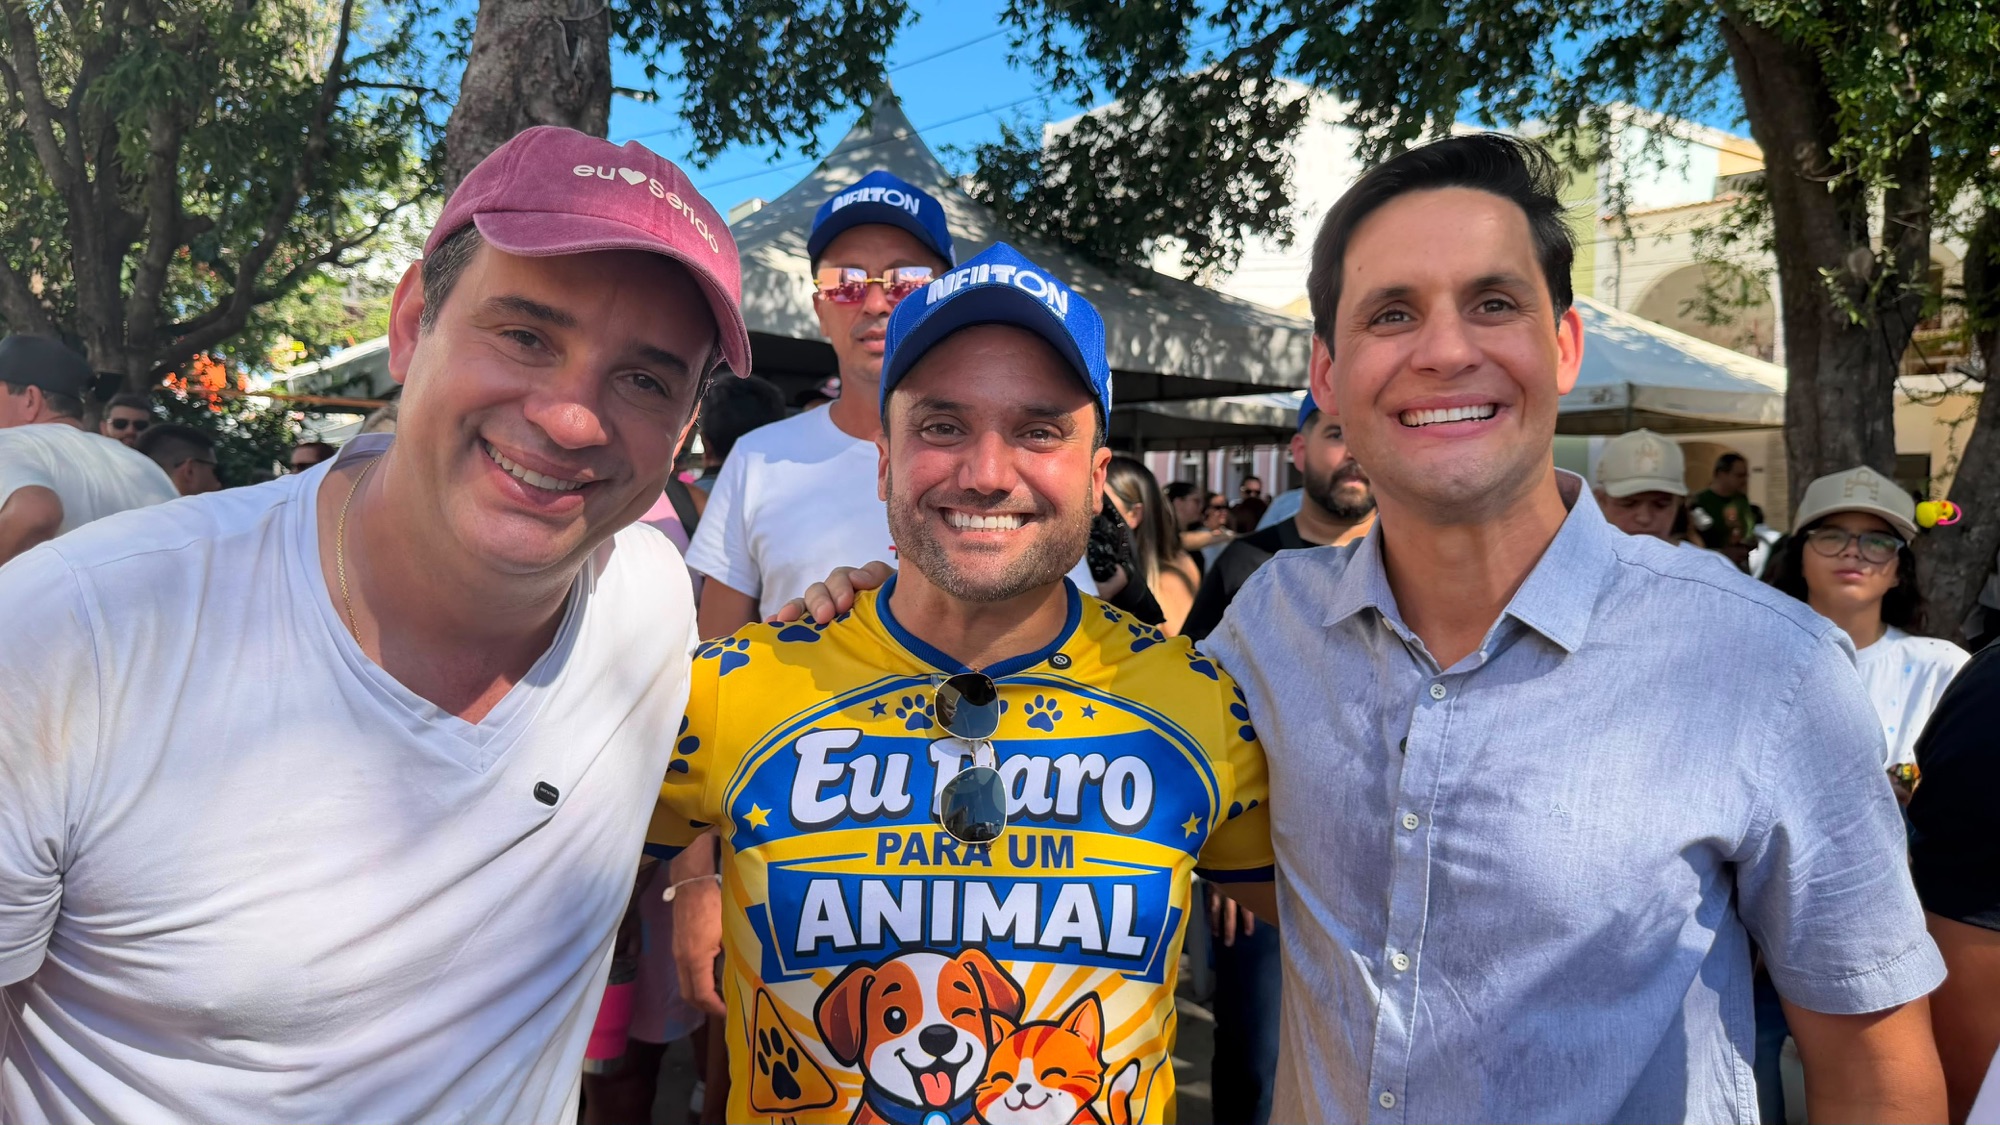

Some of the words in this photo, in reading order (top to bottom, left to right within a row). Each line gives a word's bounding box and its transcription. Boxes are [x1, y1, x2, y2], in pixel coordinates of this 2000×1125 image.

[573, 164, 616, 180] eu
[790, 728, 912, 824] Eu
[875, 832, 992, 867] PARA
[1008, 834, 1075, 869] UM
[795, 878, 1148, 957] ANIMAL
